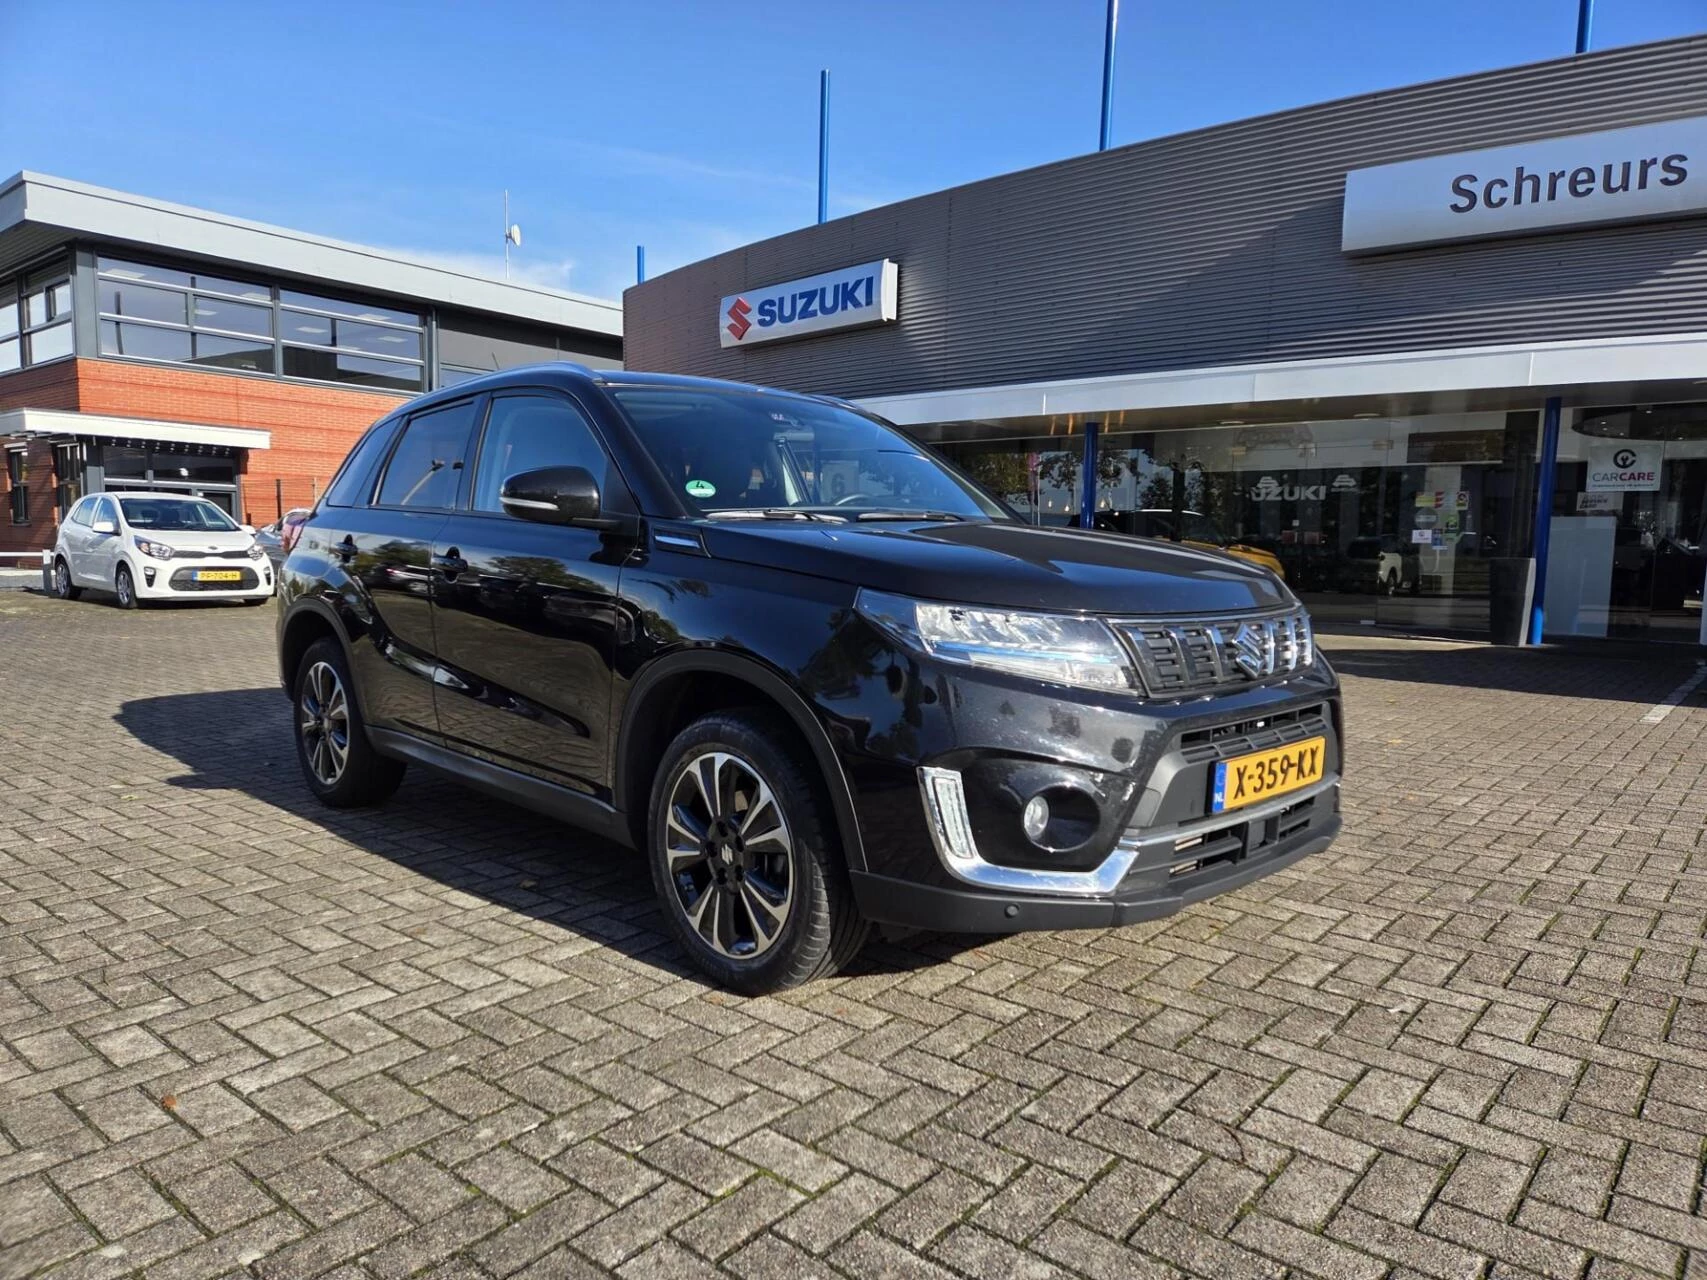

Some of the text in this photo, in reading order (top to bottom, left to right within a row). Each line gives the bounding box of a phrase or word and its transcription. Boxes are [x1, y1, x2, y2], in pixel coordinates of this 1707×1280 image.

[1450, 153, 1689, 214] Schreurs
[757, 275, 874, 328] SUZUKI
[1248, 485, 1327, 501] UZUKI
[1592, 472, 1656, 482] CARCARE
[1233, 746, 1319, 799] X-359-KX
[1214, 792, 1224, 803] NL
